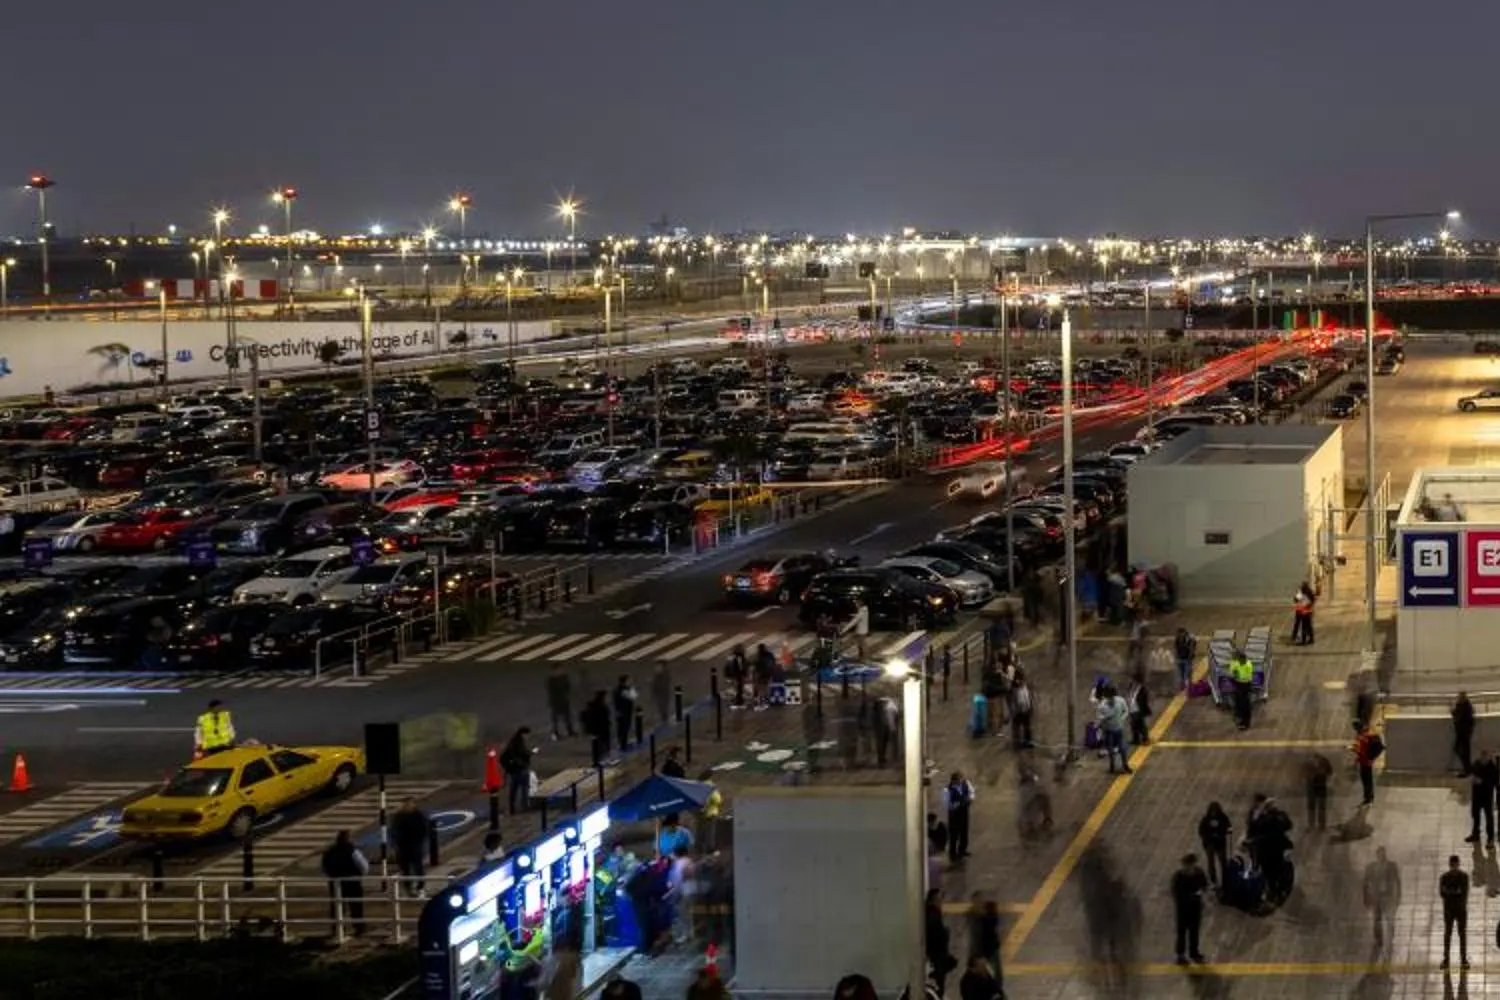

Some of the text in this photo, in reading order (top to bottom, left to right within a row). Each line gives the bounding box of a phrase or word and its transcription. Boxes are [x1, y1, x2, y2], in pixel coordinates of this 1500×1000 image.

[371, 336, 400, 352] age
[403, 329, 419, 346] of
[1420, 549, 1442, 567] E1
